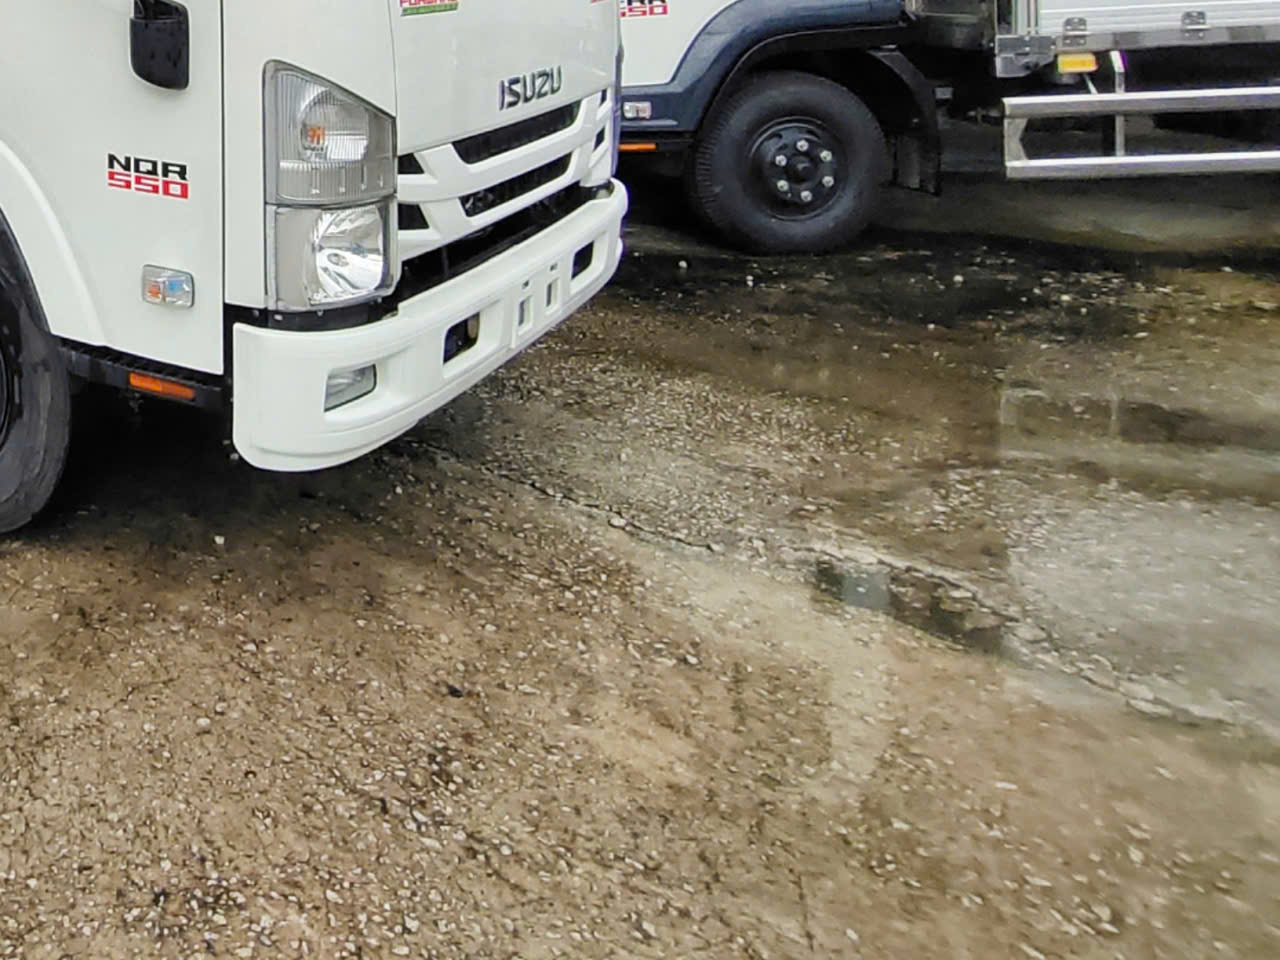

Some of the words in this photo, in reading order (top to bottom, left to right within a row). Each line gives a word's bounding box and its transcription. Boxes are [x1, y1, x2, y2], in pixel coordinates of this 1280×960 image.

[620, 4, 668, 17] 50
[499, 65, 562, 111] ISUZU
[107, 152, 188, 181] NQR
